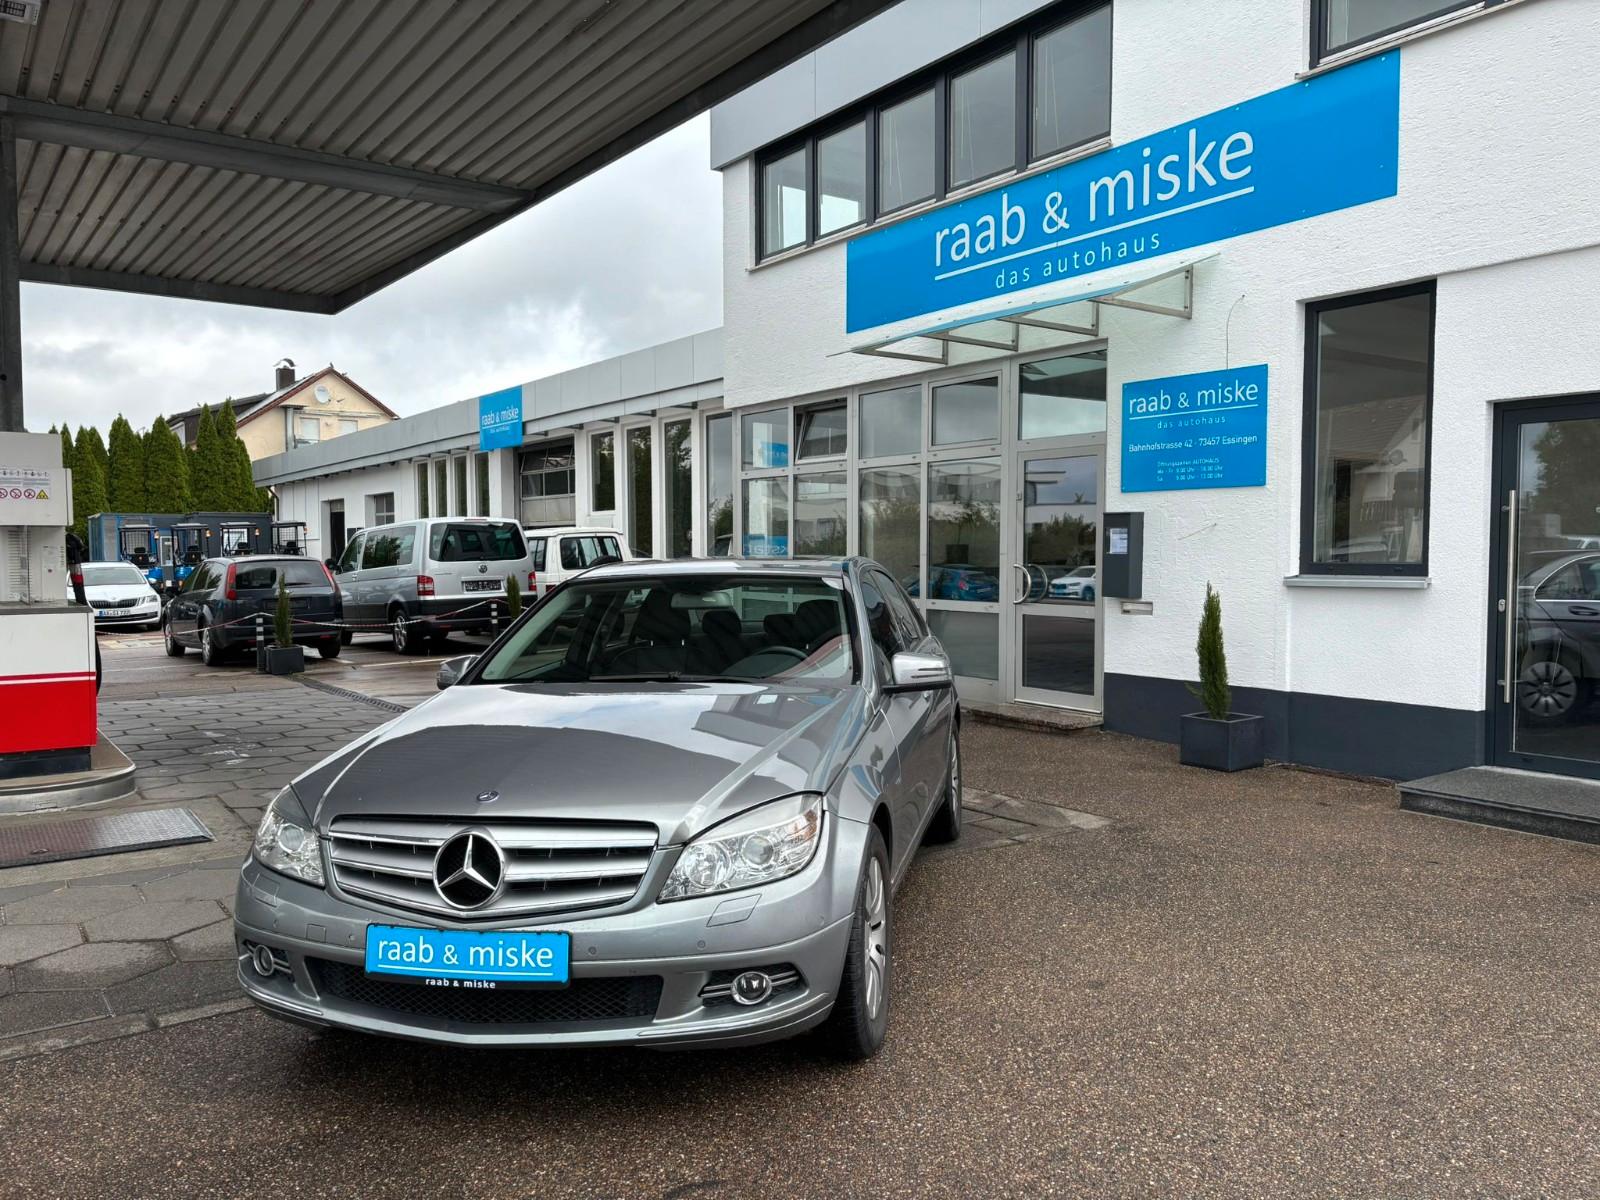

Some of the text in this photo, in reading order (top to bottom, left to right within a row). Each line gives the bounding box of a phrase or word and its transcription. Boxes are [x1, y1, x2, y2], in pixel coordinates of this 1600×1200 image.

[935, 128, 1254, 267] raab & miske
[995, 232, 1160, 288] das autohaus
[1129, 379, 1258, 414] raab & miske
[482, 410, 494, 426] raab
[500, 404, 518, 420] miske
[1157, 416, 1226, 429] das autohaus
[1129, 435, 1258, 452] Bahnhofstrasse 42 73457 Essingen
[378, 936, 553, 968] raab & miske
[426, 978, 450, 986] raab
[464, 980, 496, 988] miske
